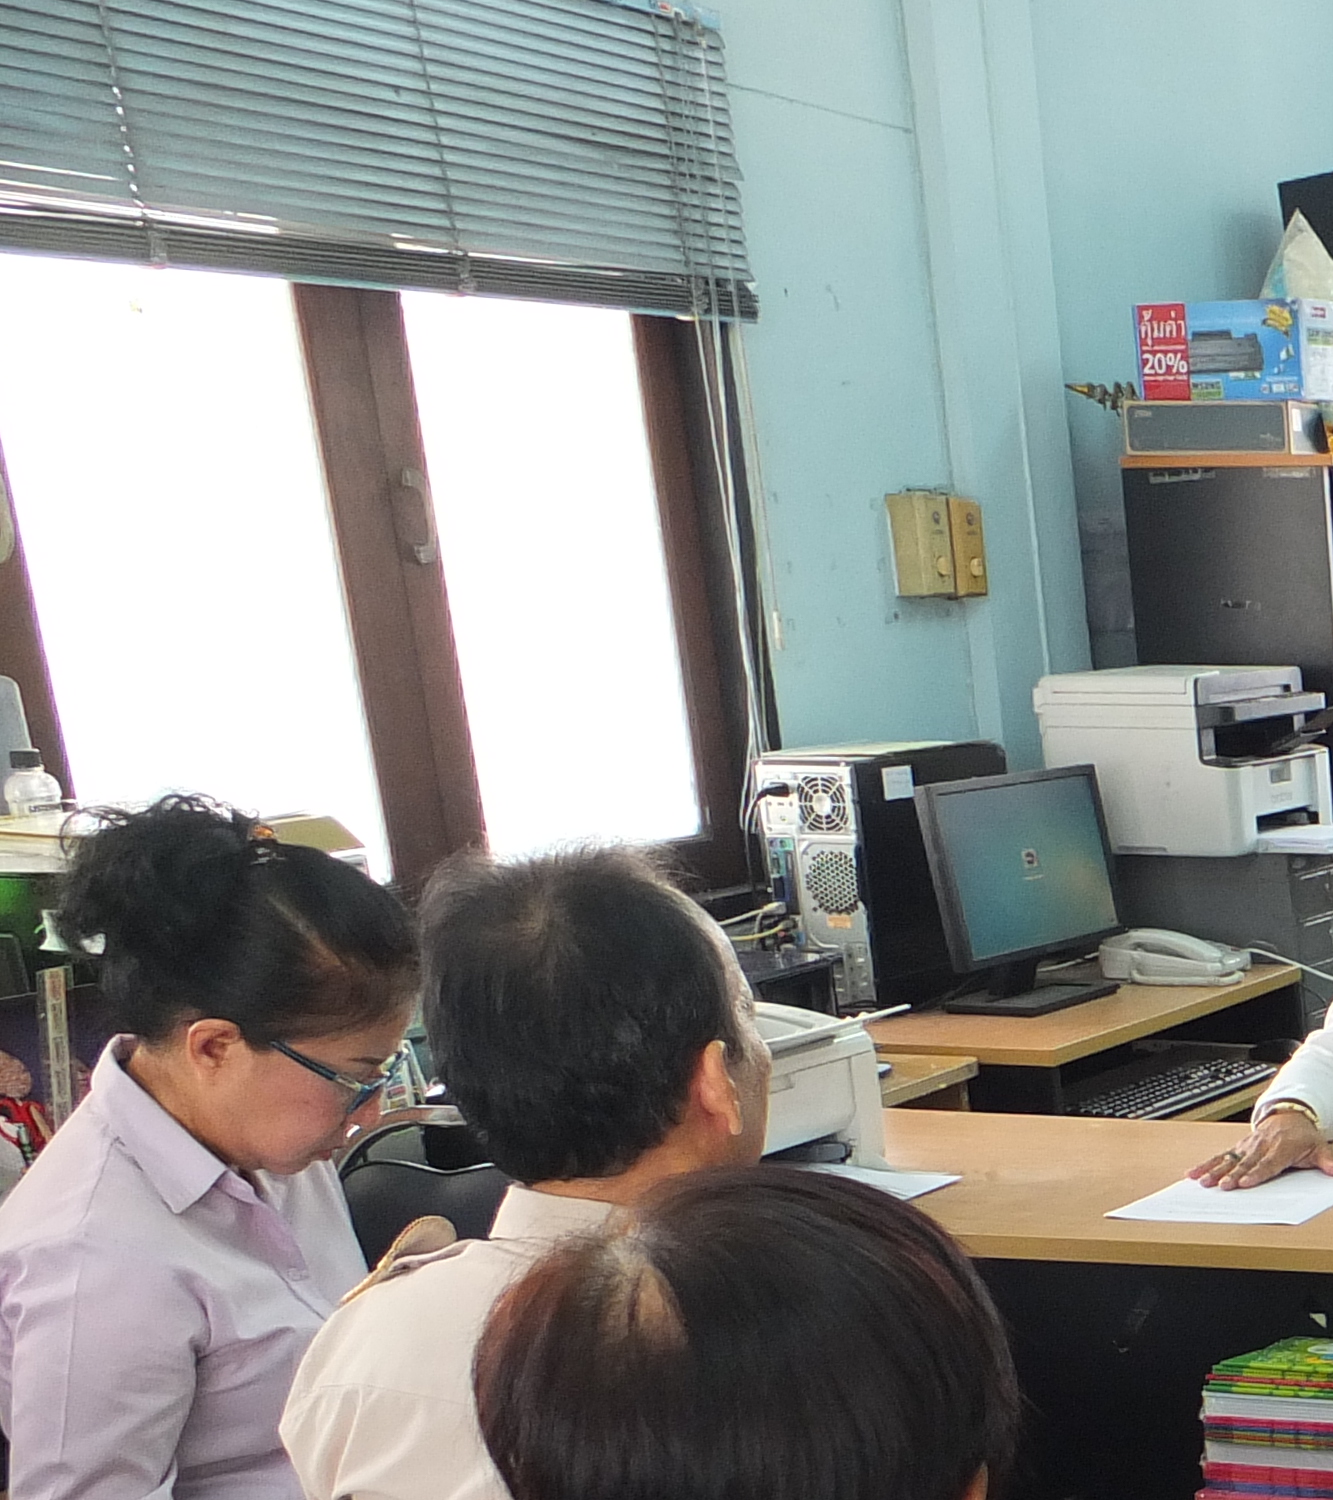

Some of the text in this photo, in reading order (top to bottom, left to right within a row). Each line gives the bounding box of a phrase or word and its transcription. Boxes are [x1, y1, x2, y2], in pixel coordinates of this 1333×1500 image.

[1140, 309, 1186, 346] คุ้มค่า
[1142, 352, 1188, 375] 20%
